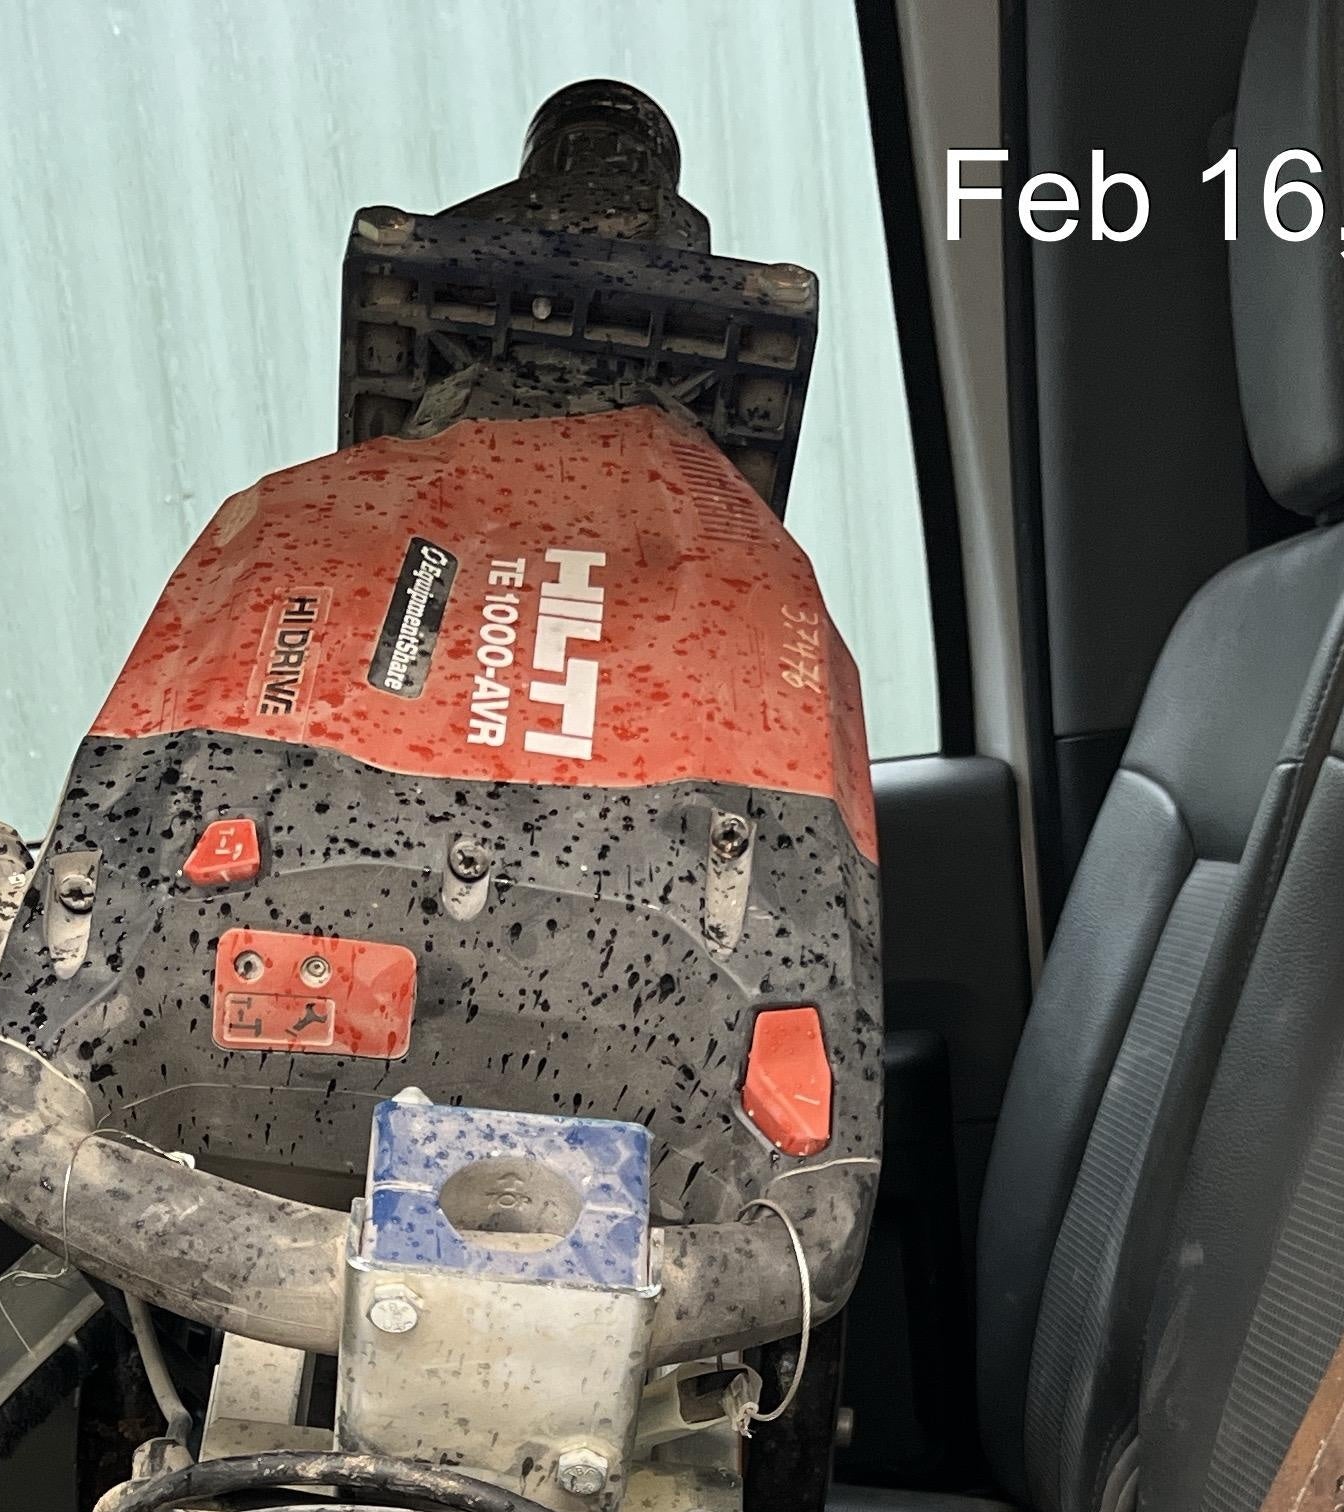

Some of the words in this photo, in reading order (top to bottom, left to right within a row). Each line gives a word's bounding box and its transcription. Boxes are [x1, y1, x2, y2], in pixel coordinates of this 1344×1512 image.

[280, 596, 319, 628] HI
[383, 558, 442, 692] EquipmentShare
[487, 557, 526, 588] TE
[258, 627, 314, 716] DRIVE
[466, 592, 521, 748] 1000-AVR
[523, 548, 606, 760] HILTI
